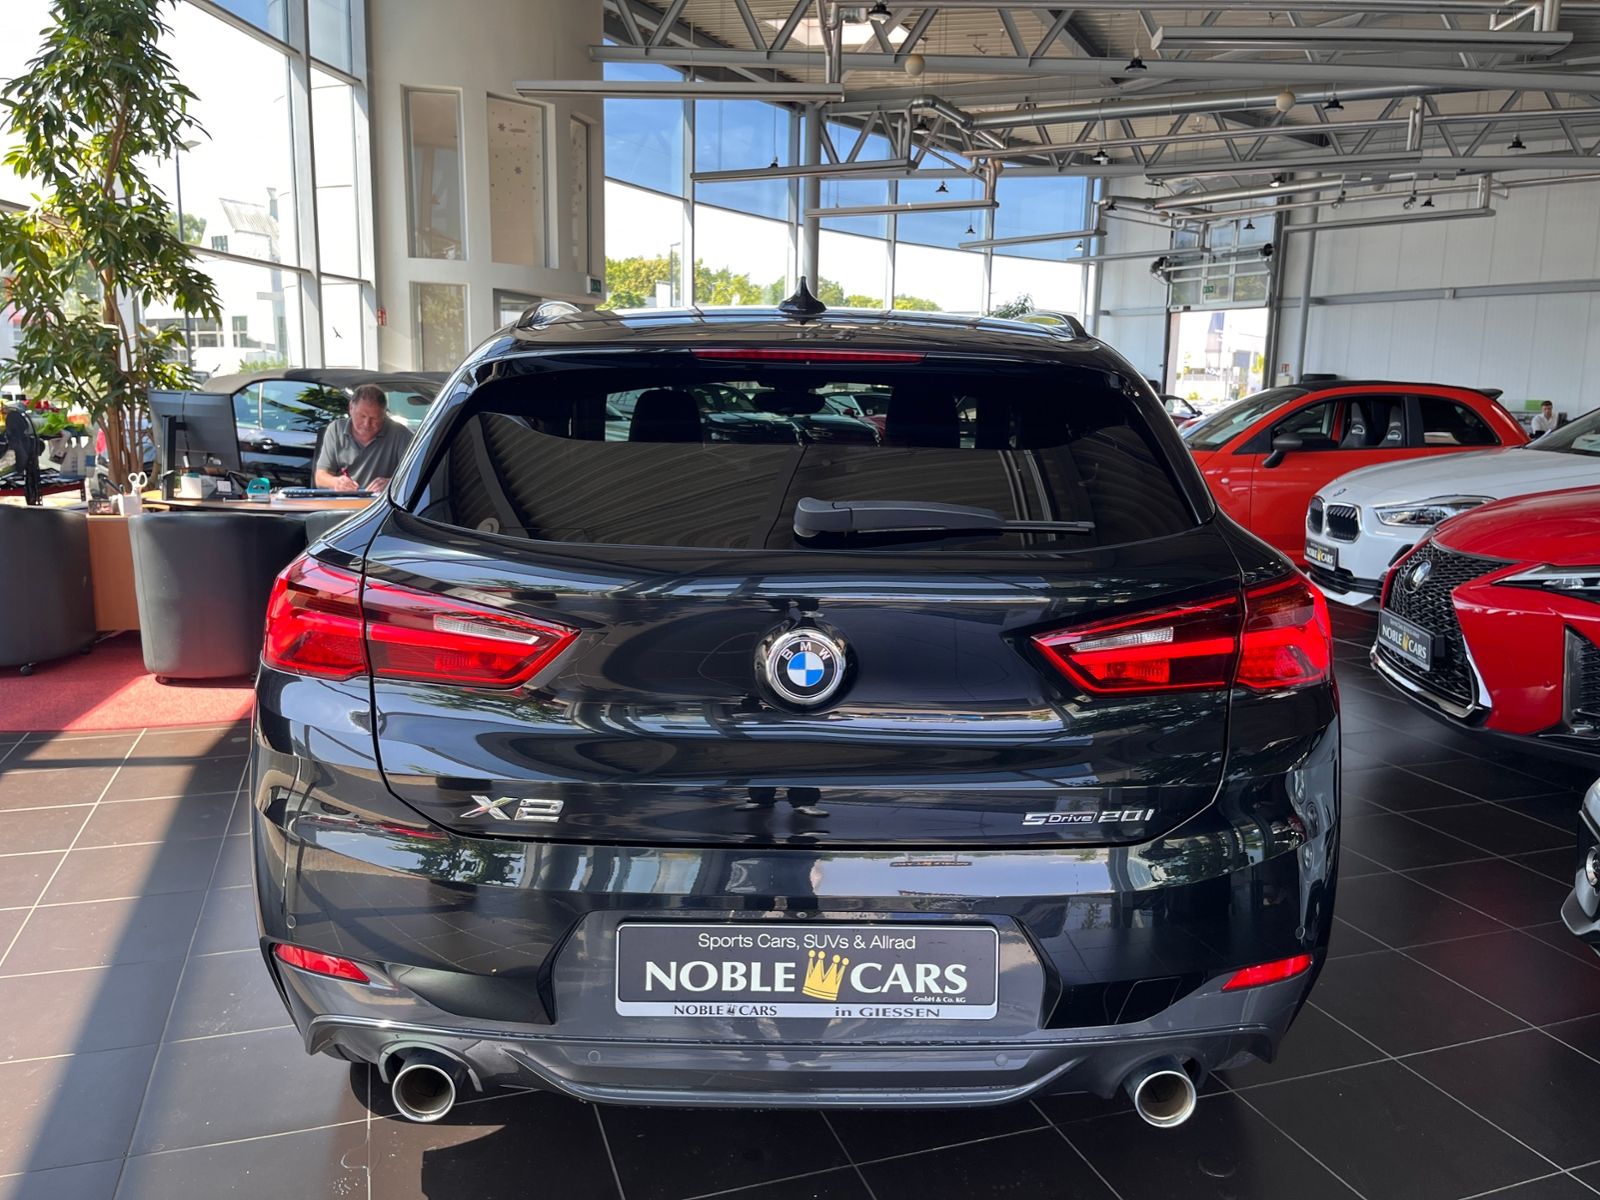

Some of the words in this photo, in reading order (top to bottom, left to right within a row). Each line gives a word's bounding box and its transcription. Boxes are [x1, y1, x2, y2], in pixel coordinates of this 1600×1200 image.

[1382, 624, 1403, 646] NOBLE
[1408, 639, 1427, 659] CARS
[781, 641, 831, 661] BMW
[460, 794, 564, 822] X2
[698, 933, 753, 950] Sports
[757, 934, 800, 950] Cars,
[803, 934, 849, 949] SUVs
[853, 935, 866, 949] &
[870, 935, 916, 949] Allrad
[645, 960, 796, 992] NOBLE
[850, 962, 968, 995] CARS
[913, 995, 935, 1003] GmbH
[936, 995, 942, 1003] &
[674, 1004, 724, 1016] NOBLE
[738, 1005, 778, 1017] CARS
[835, 1006, 852, 1017] in
[859, 1007, 940, 1018] GIESSEN
